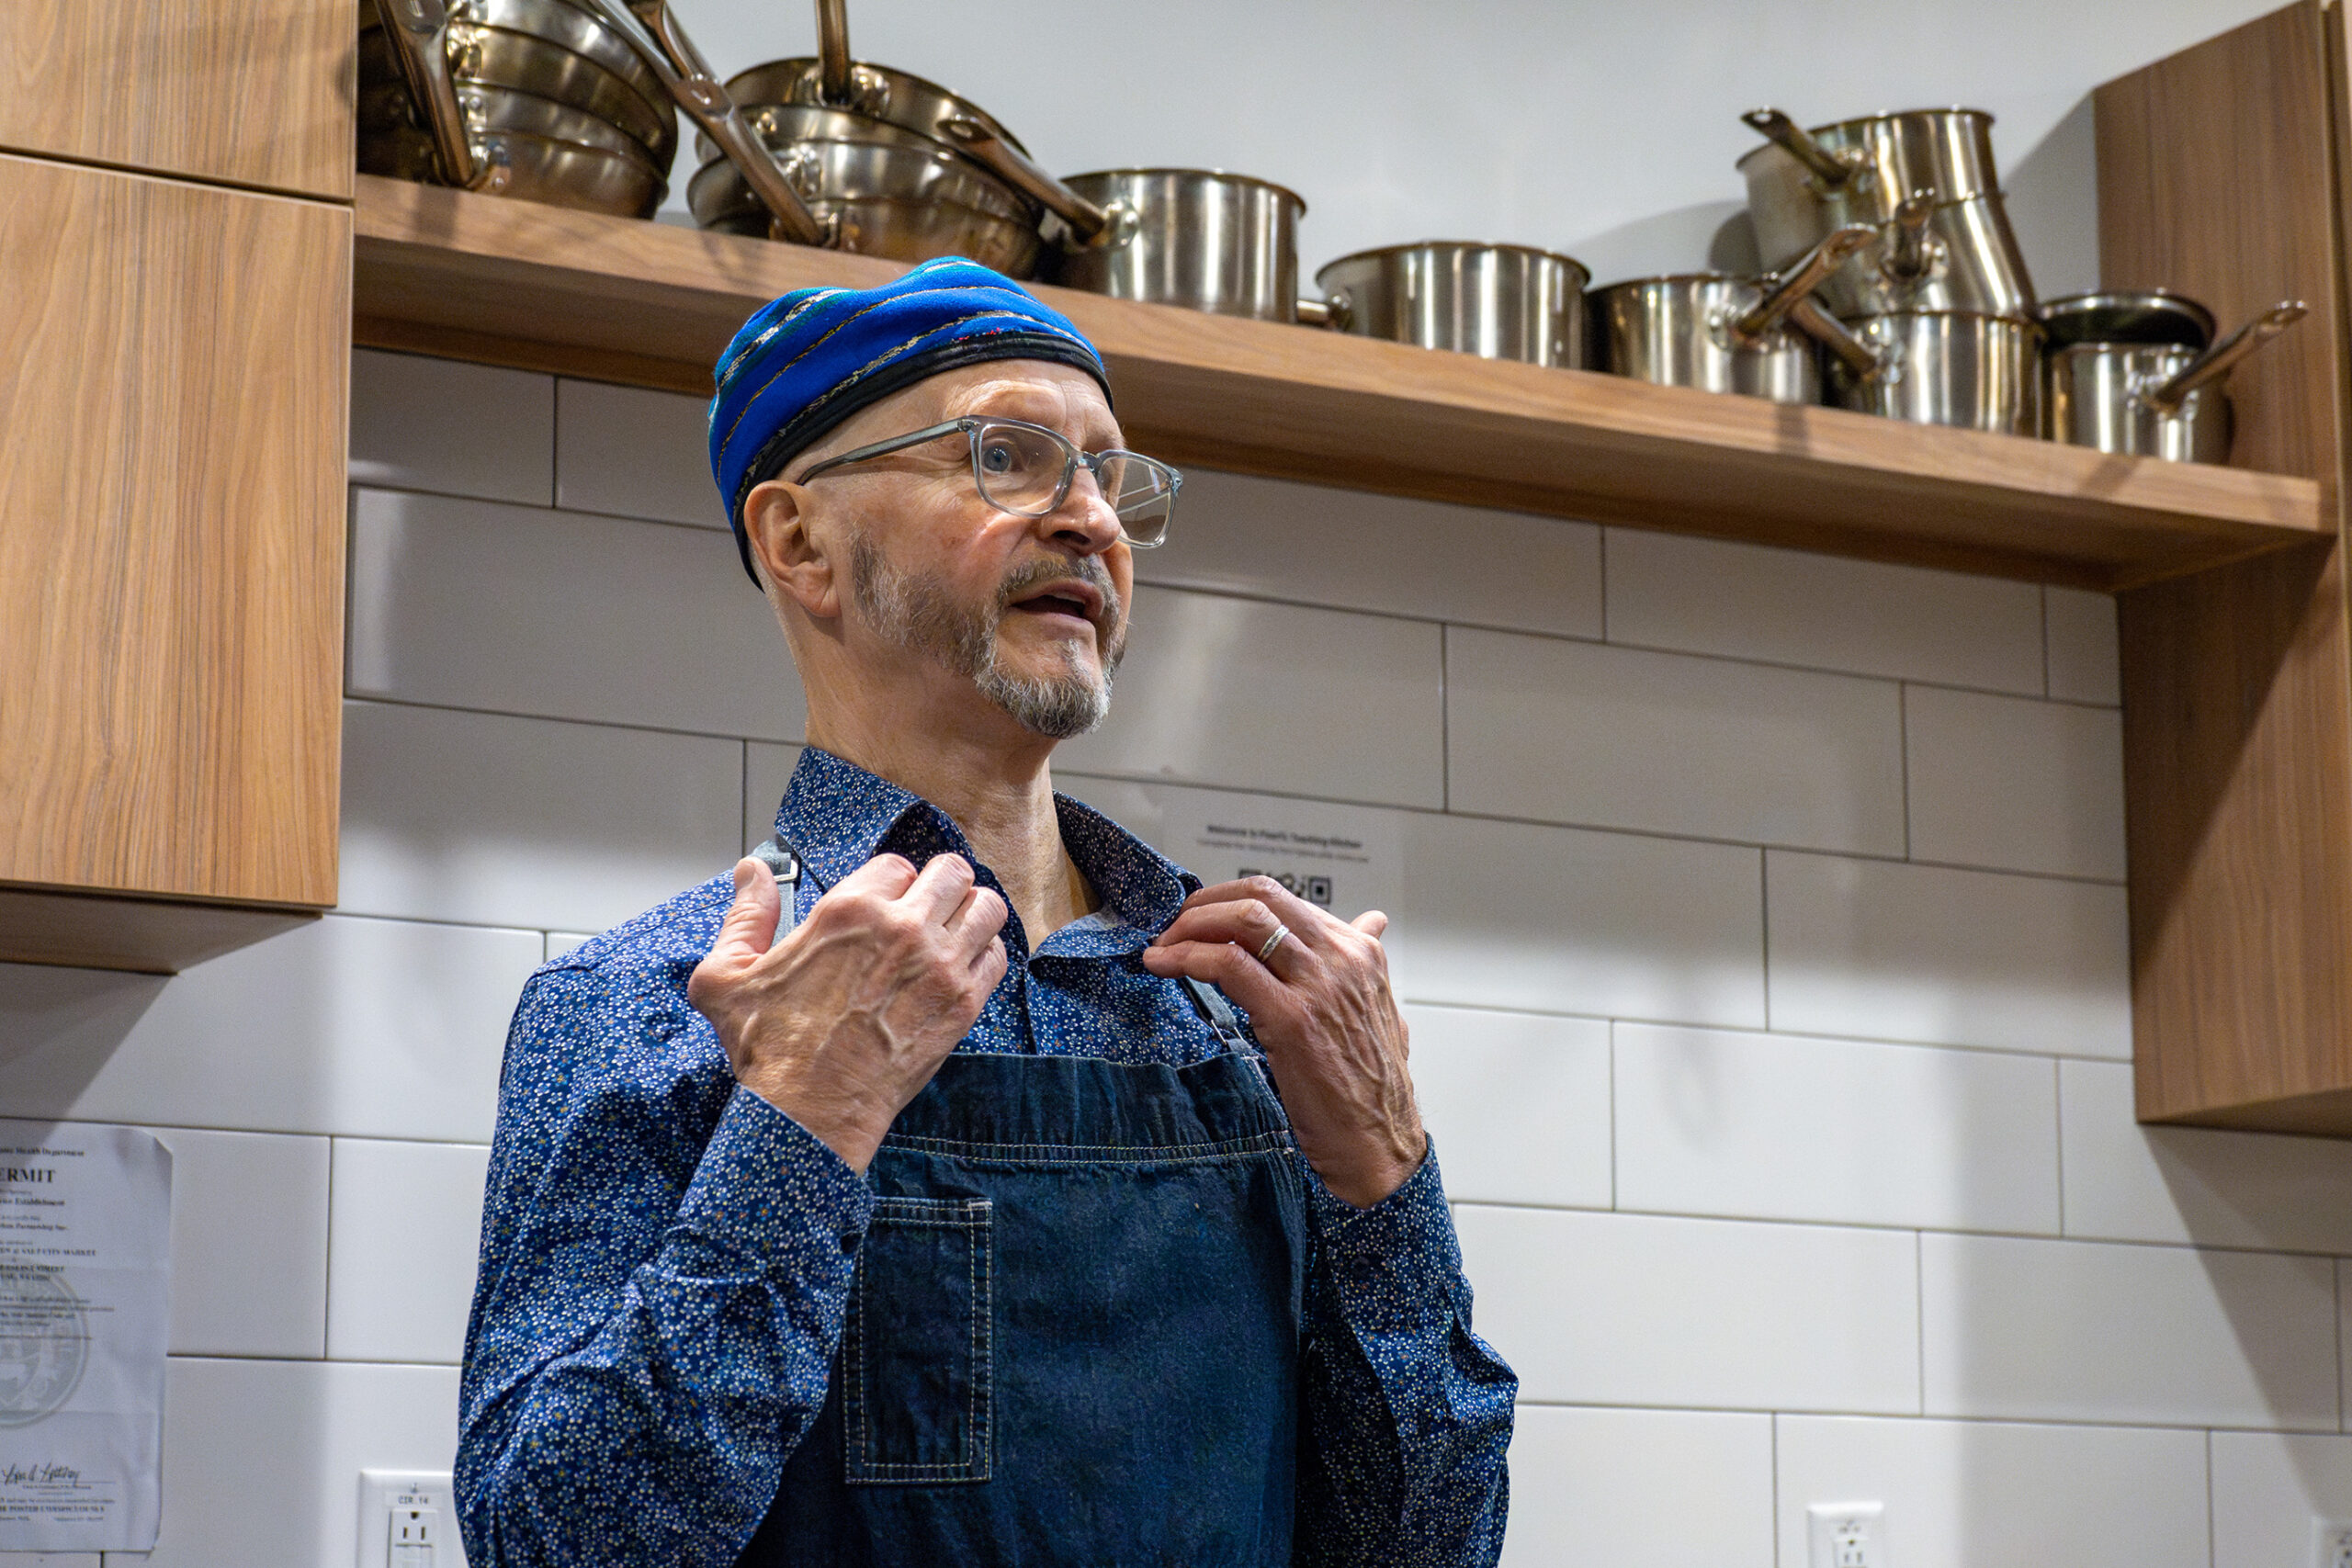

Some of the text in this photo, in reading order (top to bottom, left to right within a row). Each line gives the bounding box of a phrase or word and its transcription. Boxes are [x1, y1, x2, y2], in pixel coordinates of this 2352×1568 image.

[16, 1146, 41, 1156] Health
[42, 1146, 85, 1157] Department
[15, 1197, 65, 1206] Establishment
